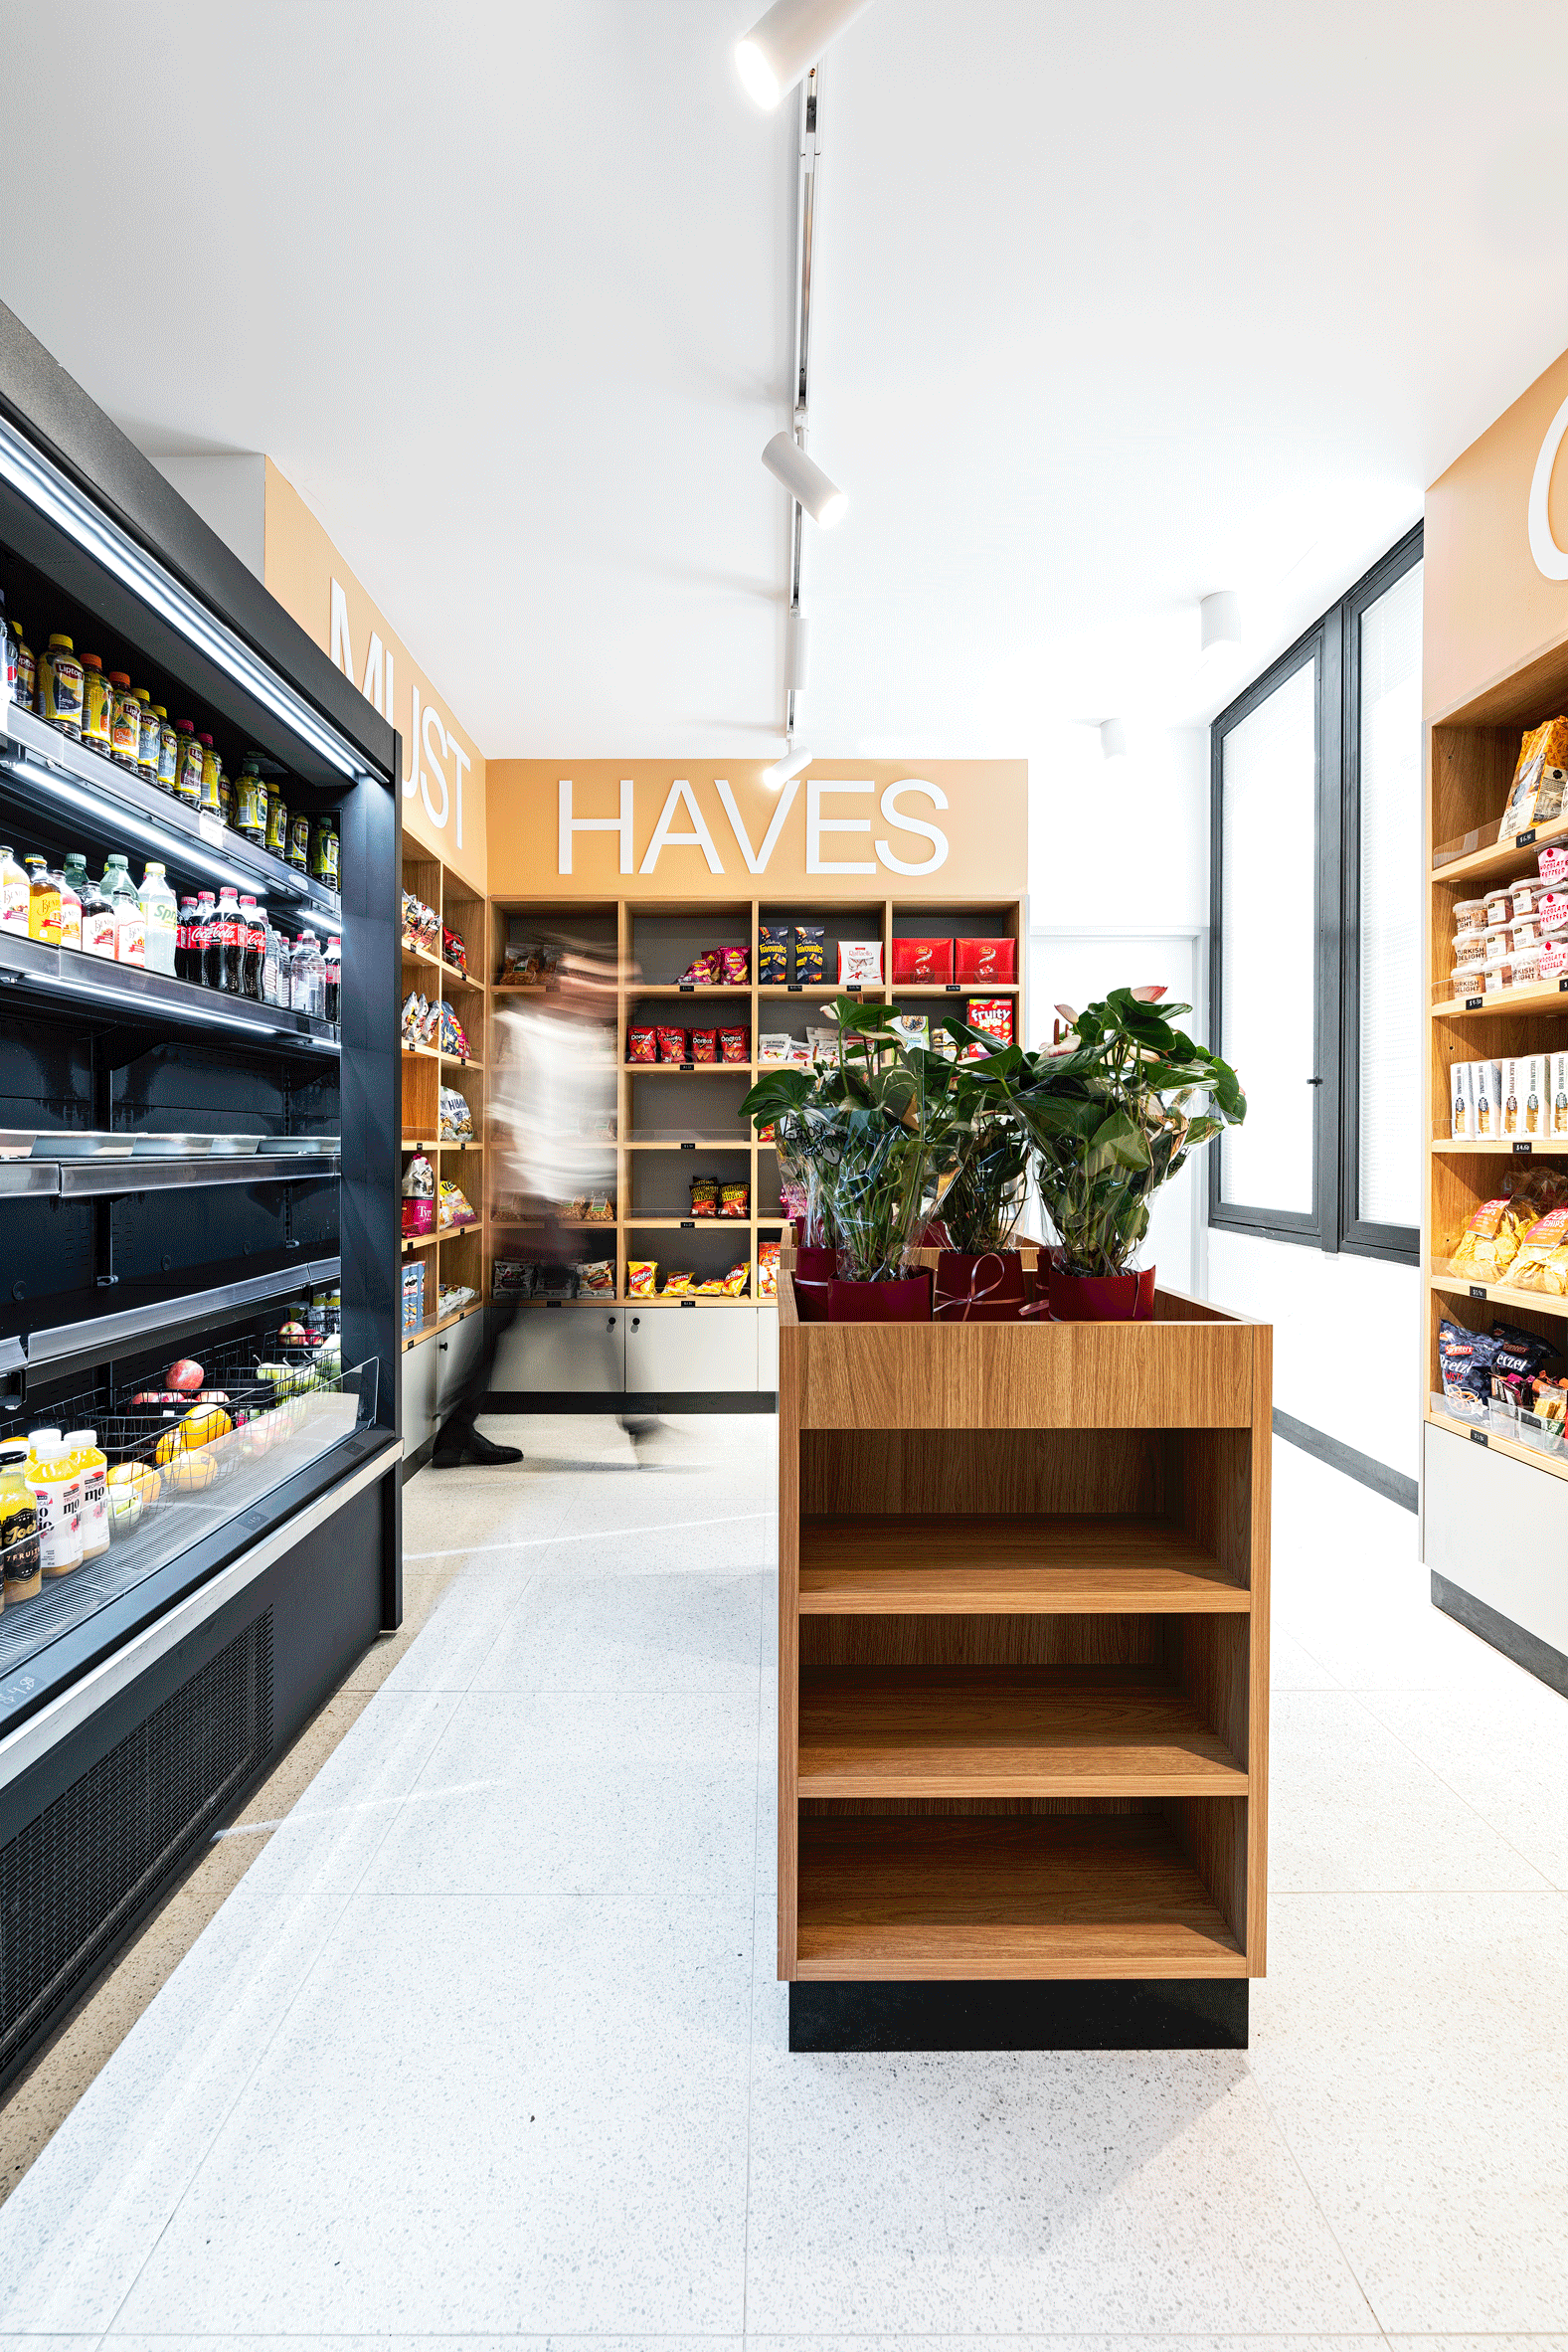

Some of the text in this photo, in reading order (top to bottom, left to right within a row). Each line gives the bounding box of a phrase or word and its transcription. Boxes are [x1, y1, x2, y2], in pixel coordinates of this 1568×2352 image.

[58, 664, 84, 678] Lipton
[330, 576, 471, 850] MUST
[558, 779, 950, 876] HAVES
[971, 1008, 1012, 1021] fruity
[1543, 1219, 1565, 1228] CHIPS
[630, 1271, 653, 1285] Twisties
